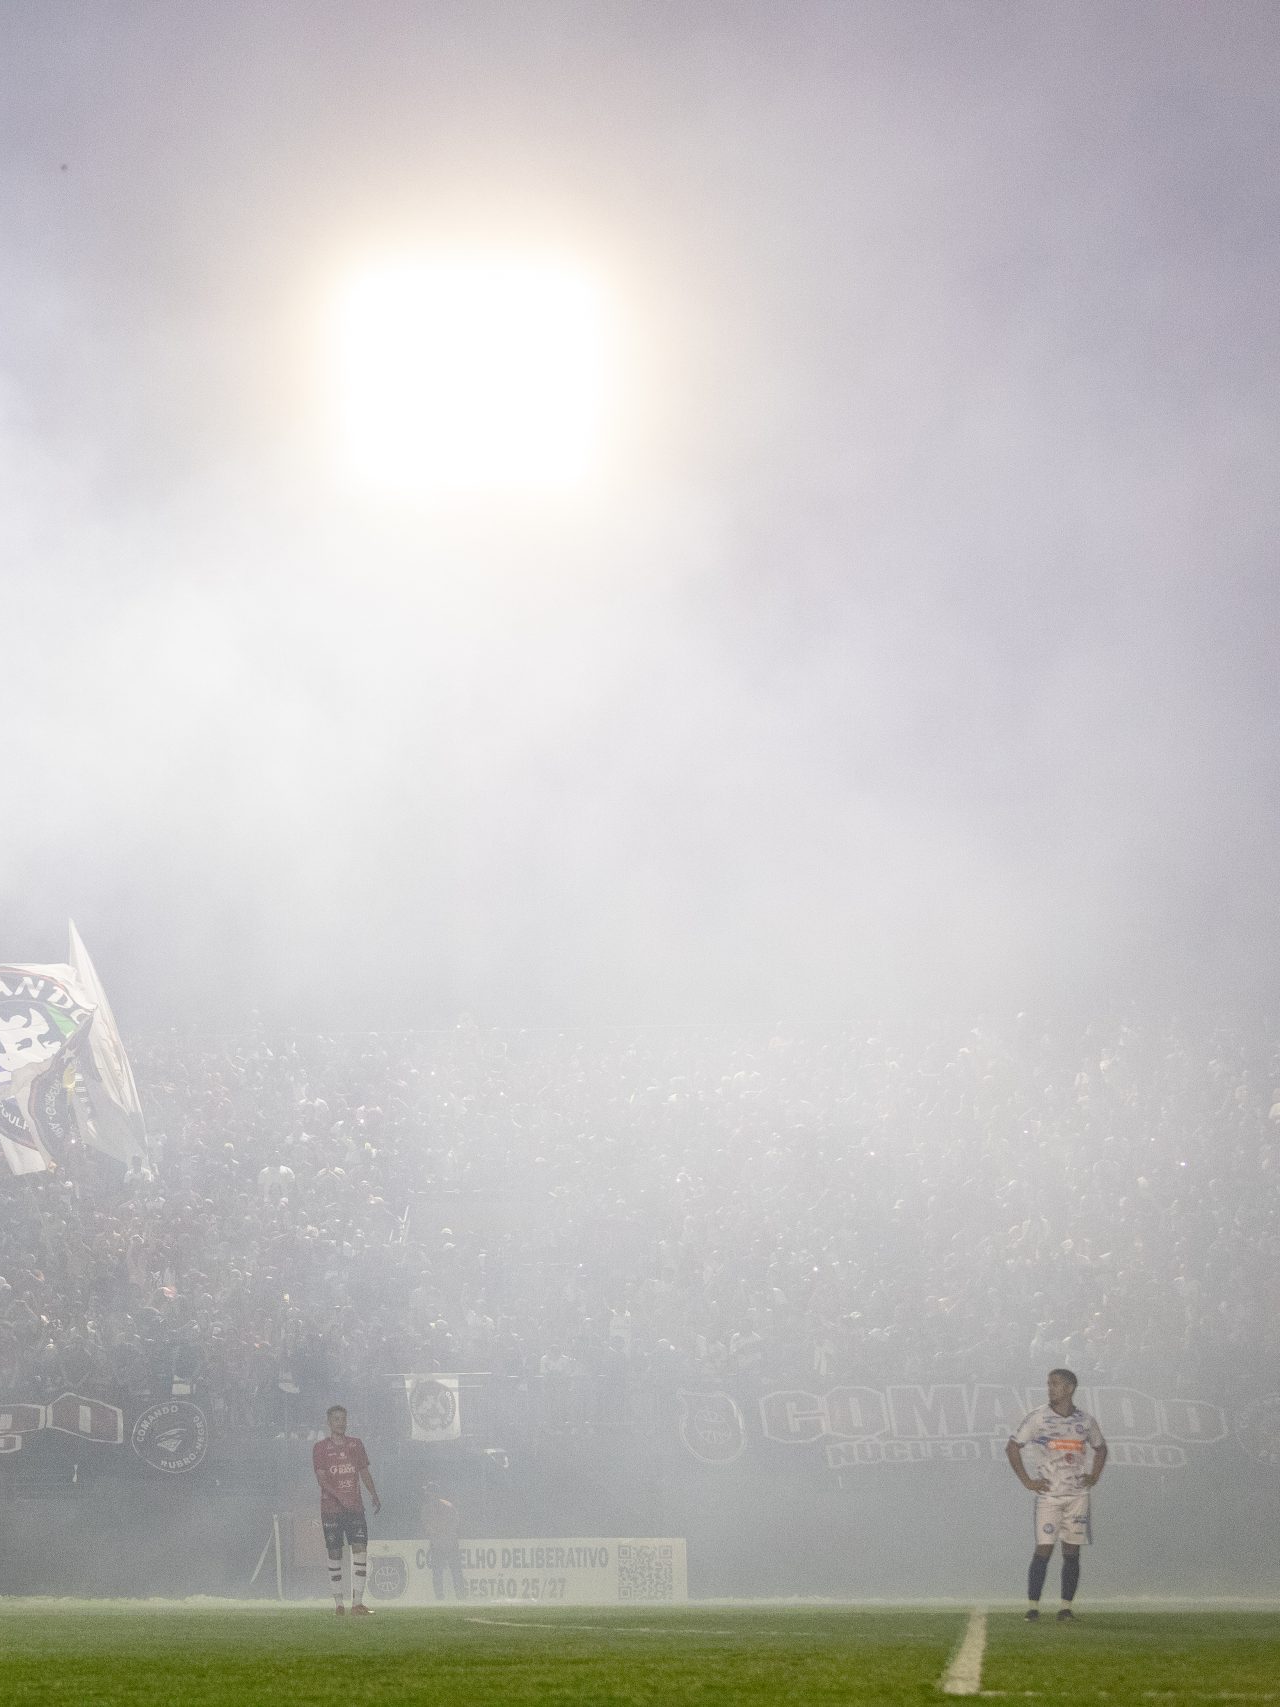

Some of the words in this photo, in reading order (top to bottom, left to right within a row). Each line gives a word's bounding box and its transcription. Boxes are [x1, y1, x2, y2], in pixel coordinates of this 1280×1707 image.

[136, 1404, 179, 1443] COMANDO
[415, 1548, 497, 1570] CELHO
[501, 1547, 609, 1569] DELIBERATIVO
[521, 1577, 567, 1599] 25/27
